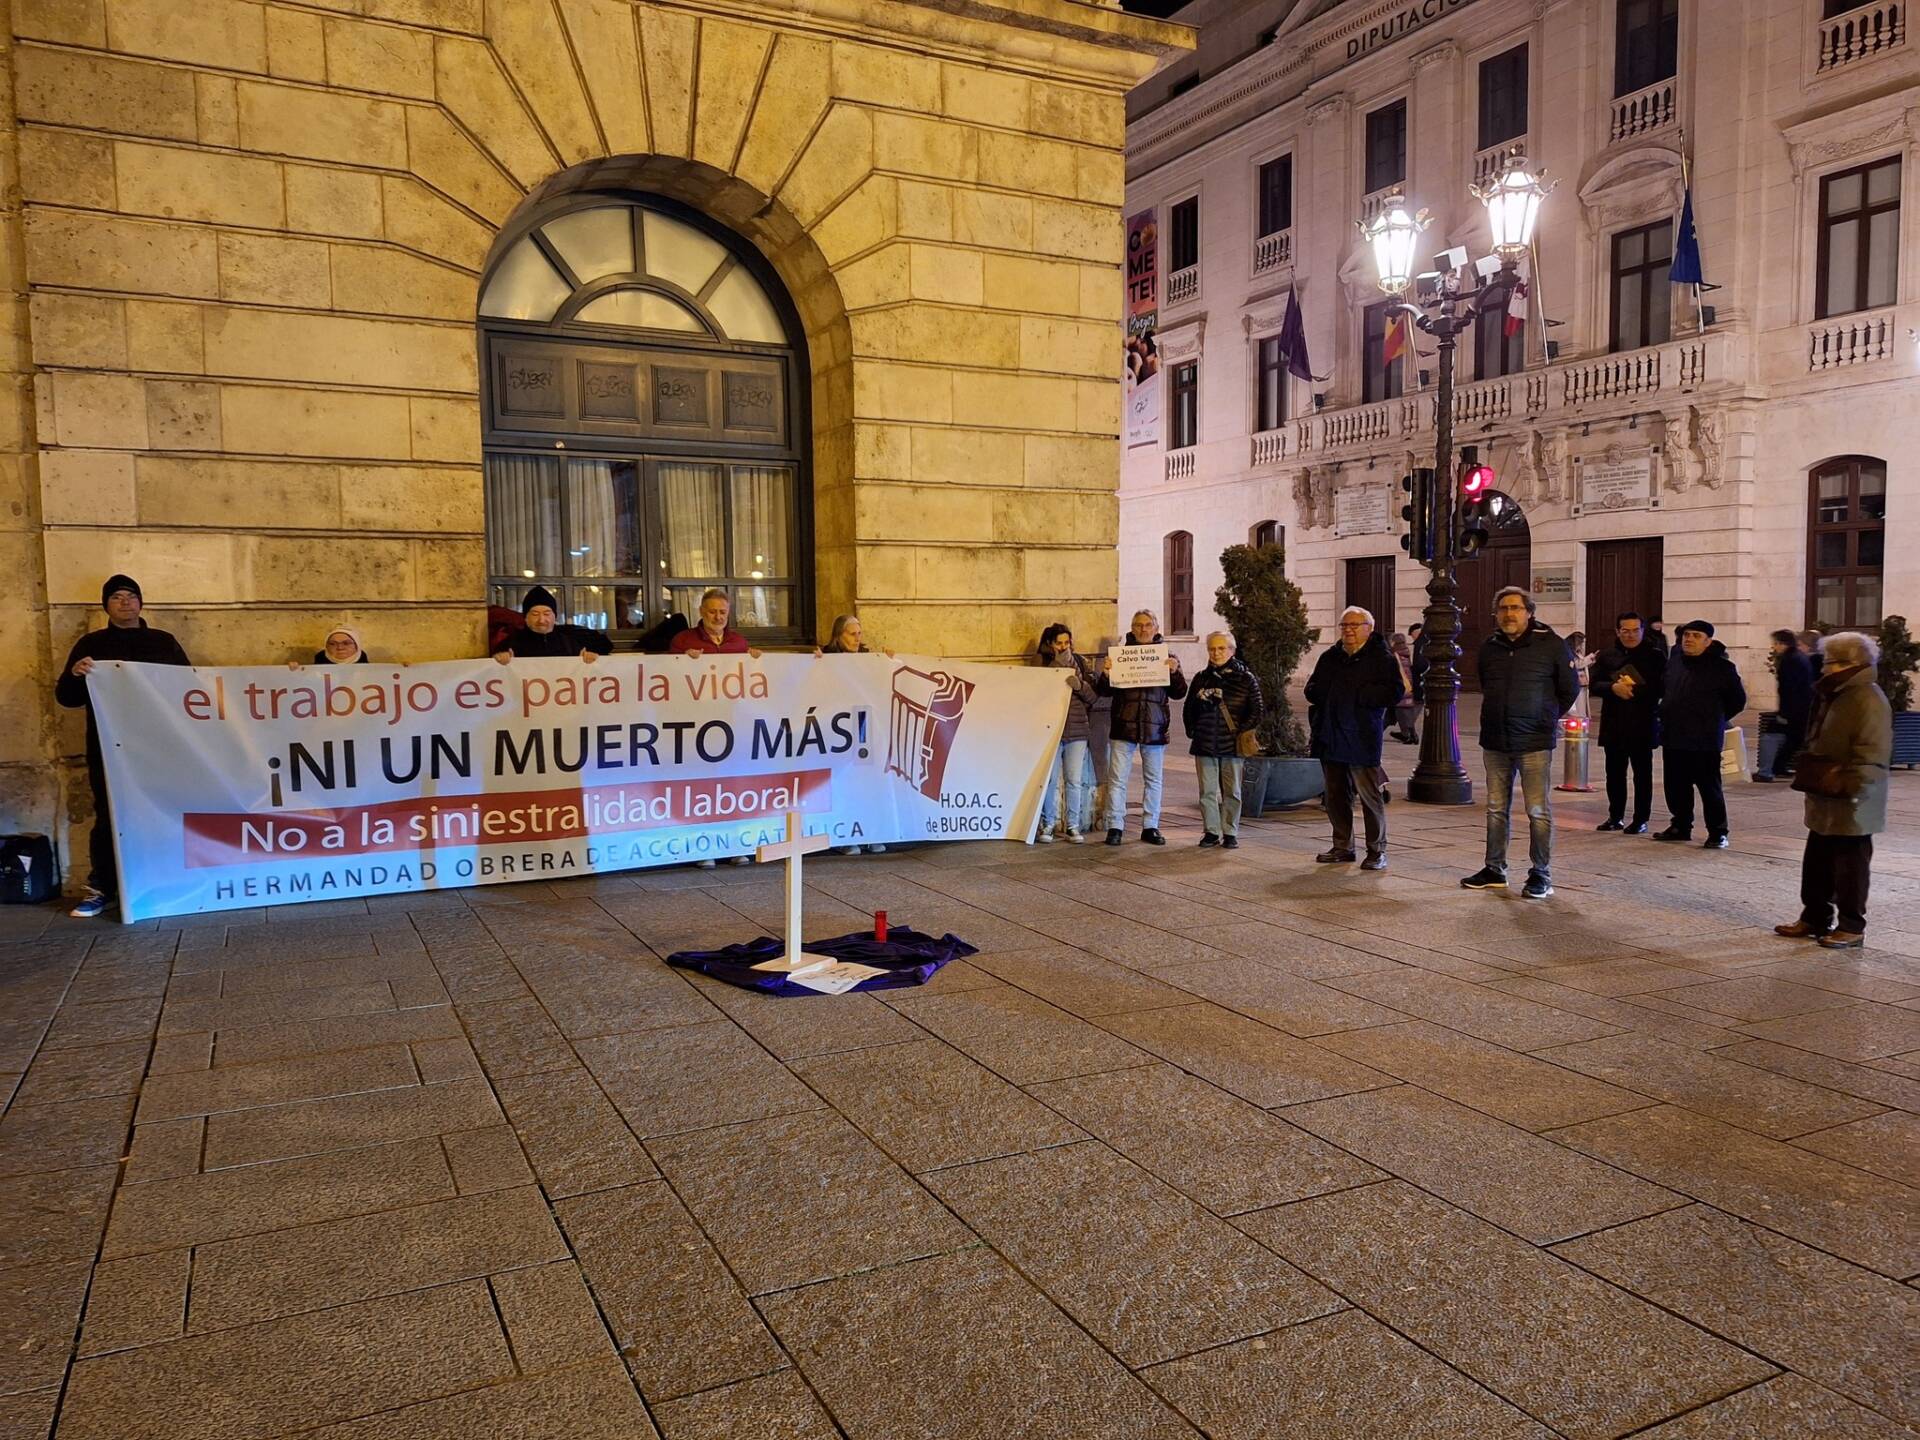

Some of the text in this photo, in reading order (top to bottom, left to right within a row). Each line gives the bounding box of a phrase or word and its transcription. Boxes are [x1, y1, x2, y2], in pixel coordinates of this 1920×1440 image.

[184, 662, 769, 725] el trabajo es para la vida
[268, 706, 869, 807] ¡NI UN MUERTO MÁS!
[241, 777, 807, 853] No a la siniestralidad laboral.
[925, 816, 1002, 833] de BURGOS
[940, 792, 1002, 808] H.O.A.C.
[215, 861, 438, 900] HERMANDAD
[455, 850, 576, 878] OBRERA
[587, 847, 619, 866] DE
[629, 831, 731, 861] ACCIÓN
